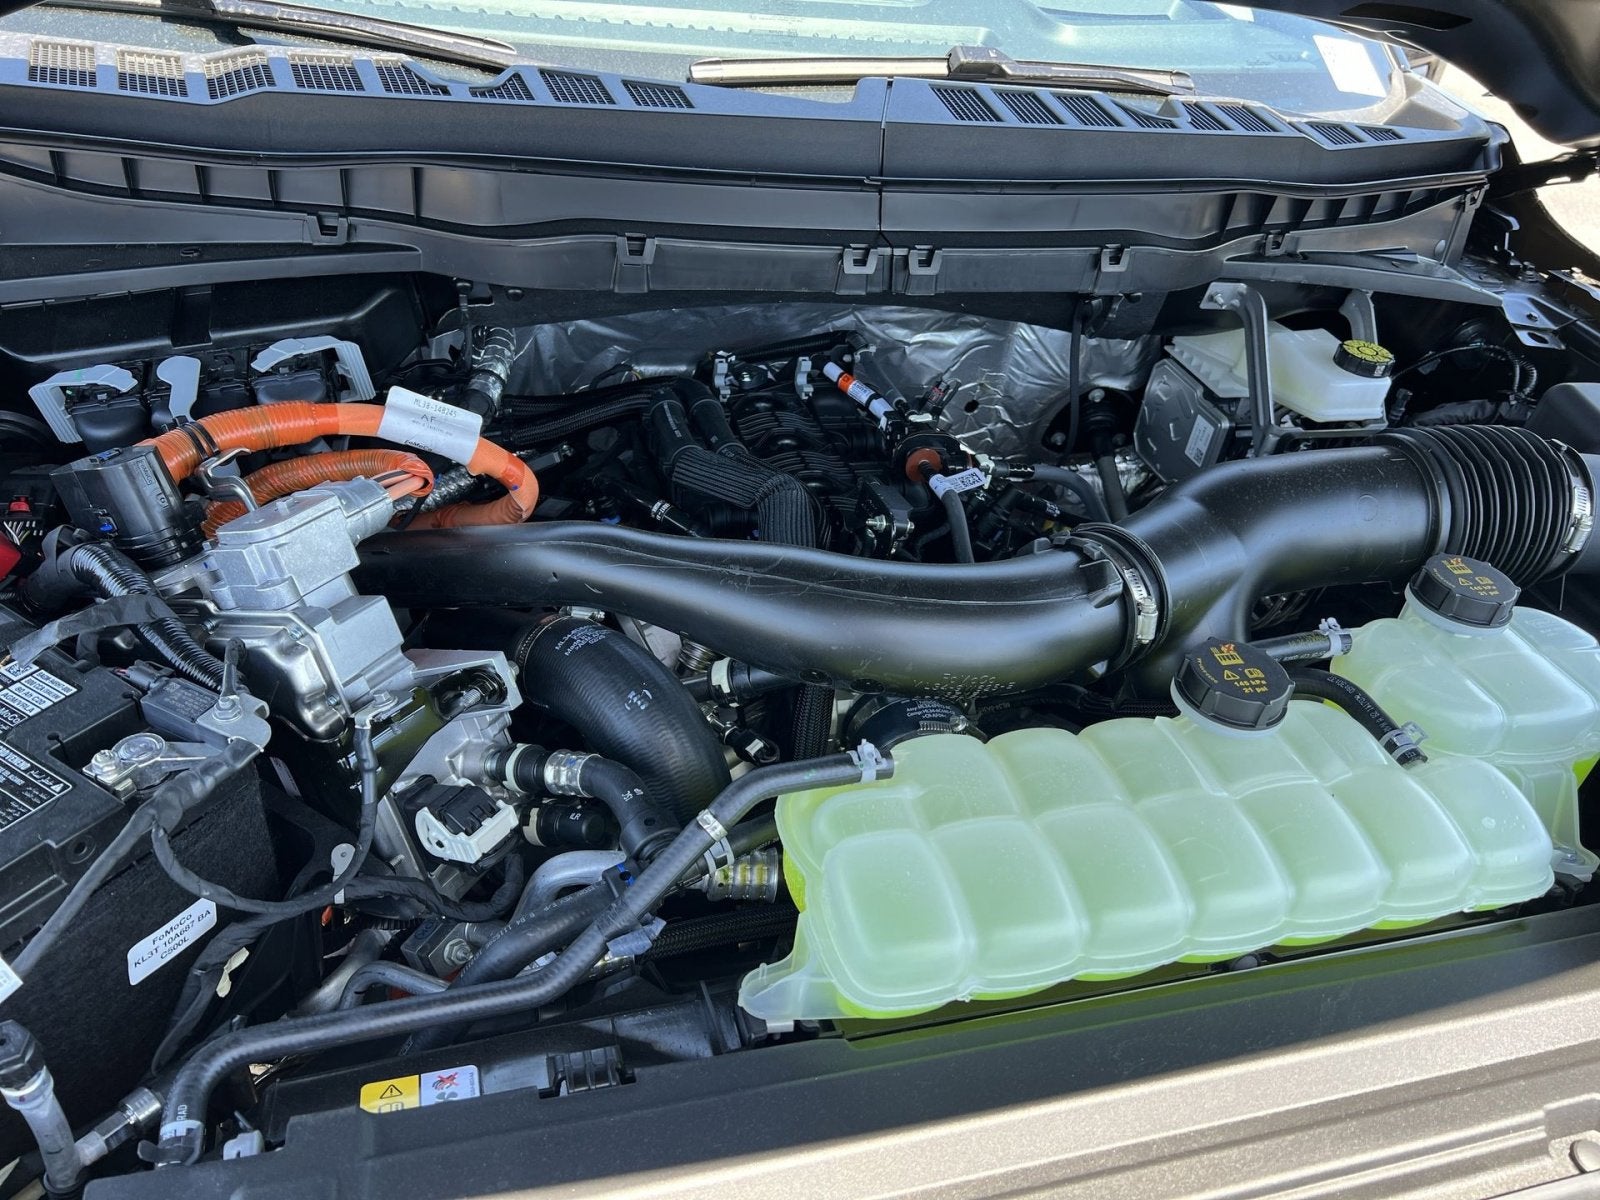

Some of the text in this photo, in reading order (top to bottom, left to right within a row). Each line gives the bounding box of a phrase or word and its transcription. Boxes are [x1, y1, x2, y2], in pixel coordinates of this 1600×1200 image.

[133, 909, 212, 969] KL3T 10A687 BA
[151, 913, 193, 946] FoMoCo
[160, 935, 191, 960] C500L
